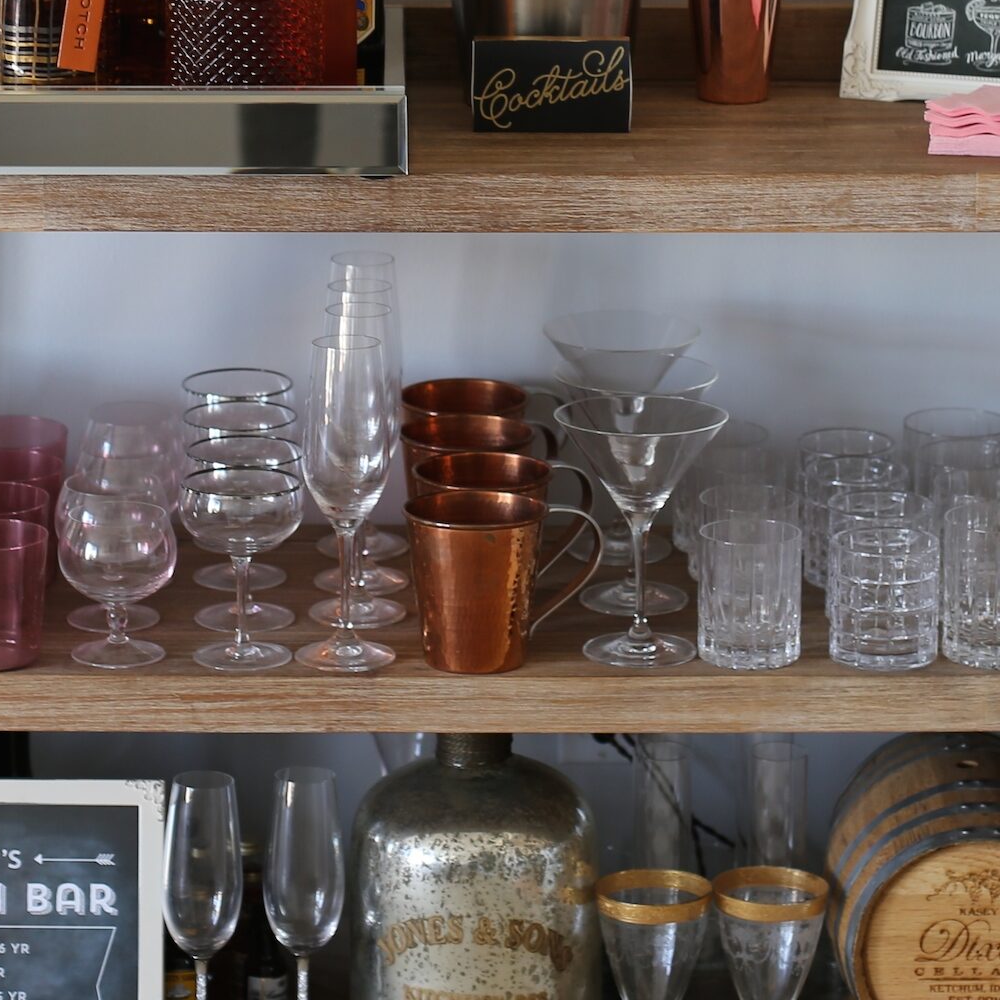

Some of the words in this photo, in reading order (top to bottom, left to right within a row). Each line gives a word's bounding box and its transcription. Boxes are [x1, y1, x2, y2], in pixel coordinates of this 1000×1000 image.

[909, 22, 951, 40] BOURBON
[474, 46, 630, 129] Cocktails
[26, 882, 119, 916] BAR
[11, 943, 30, 955] YR
[377, 915, 465, 966] JONES
[472, 916, 501, 946] &
[8, 991, 28, 1000] YR
